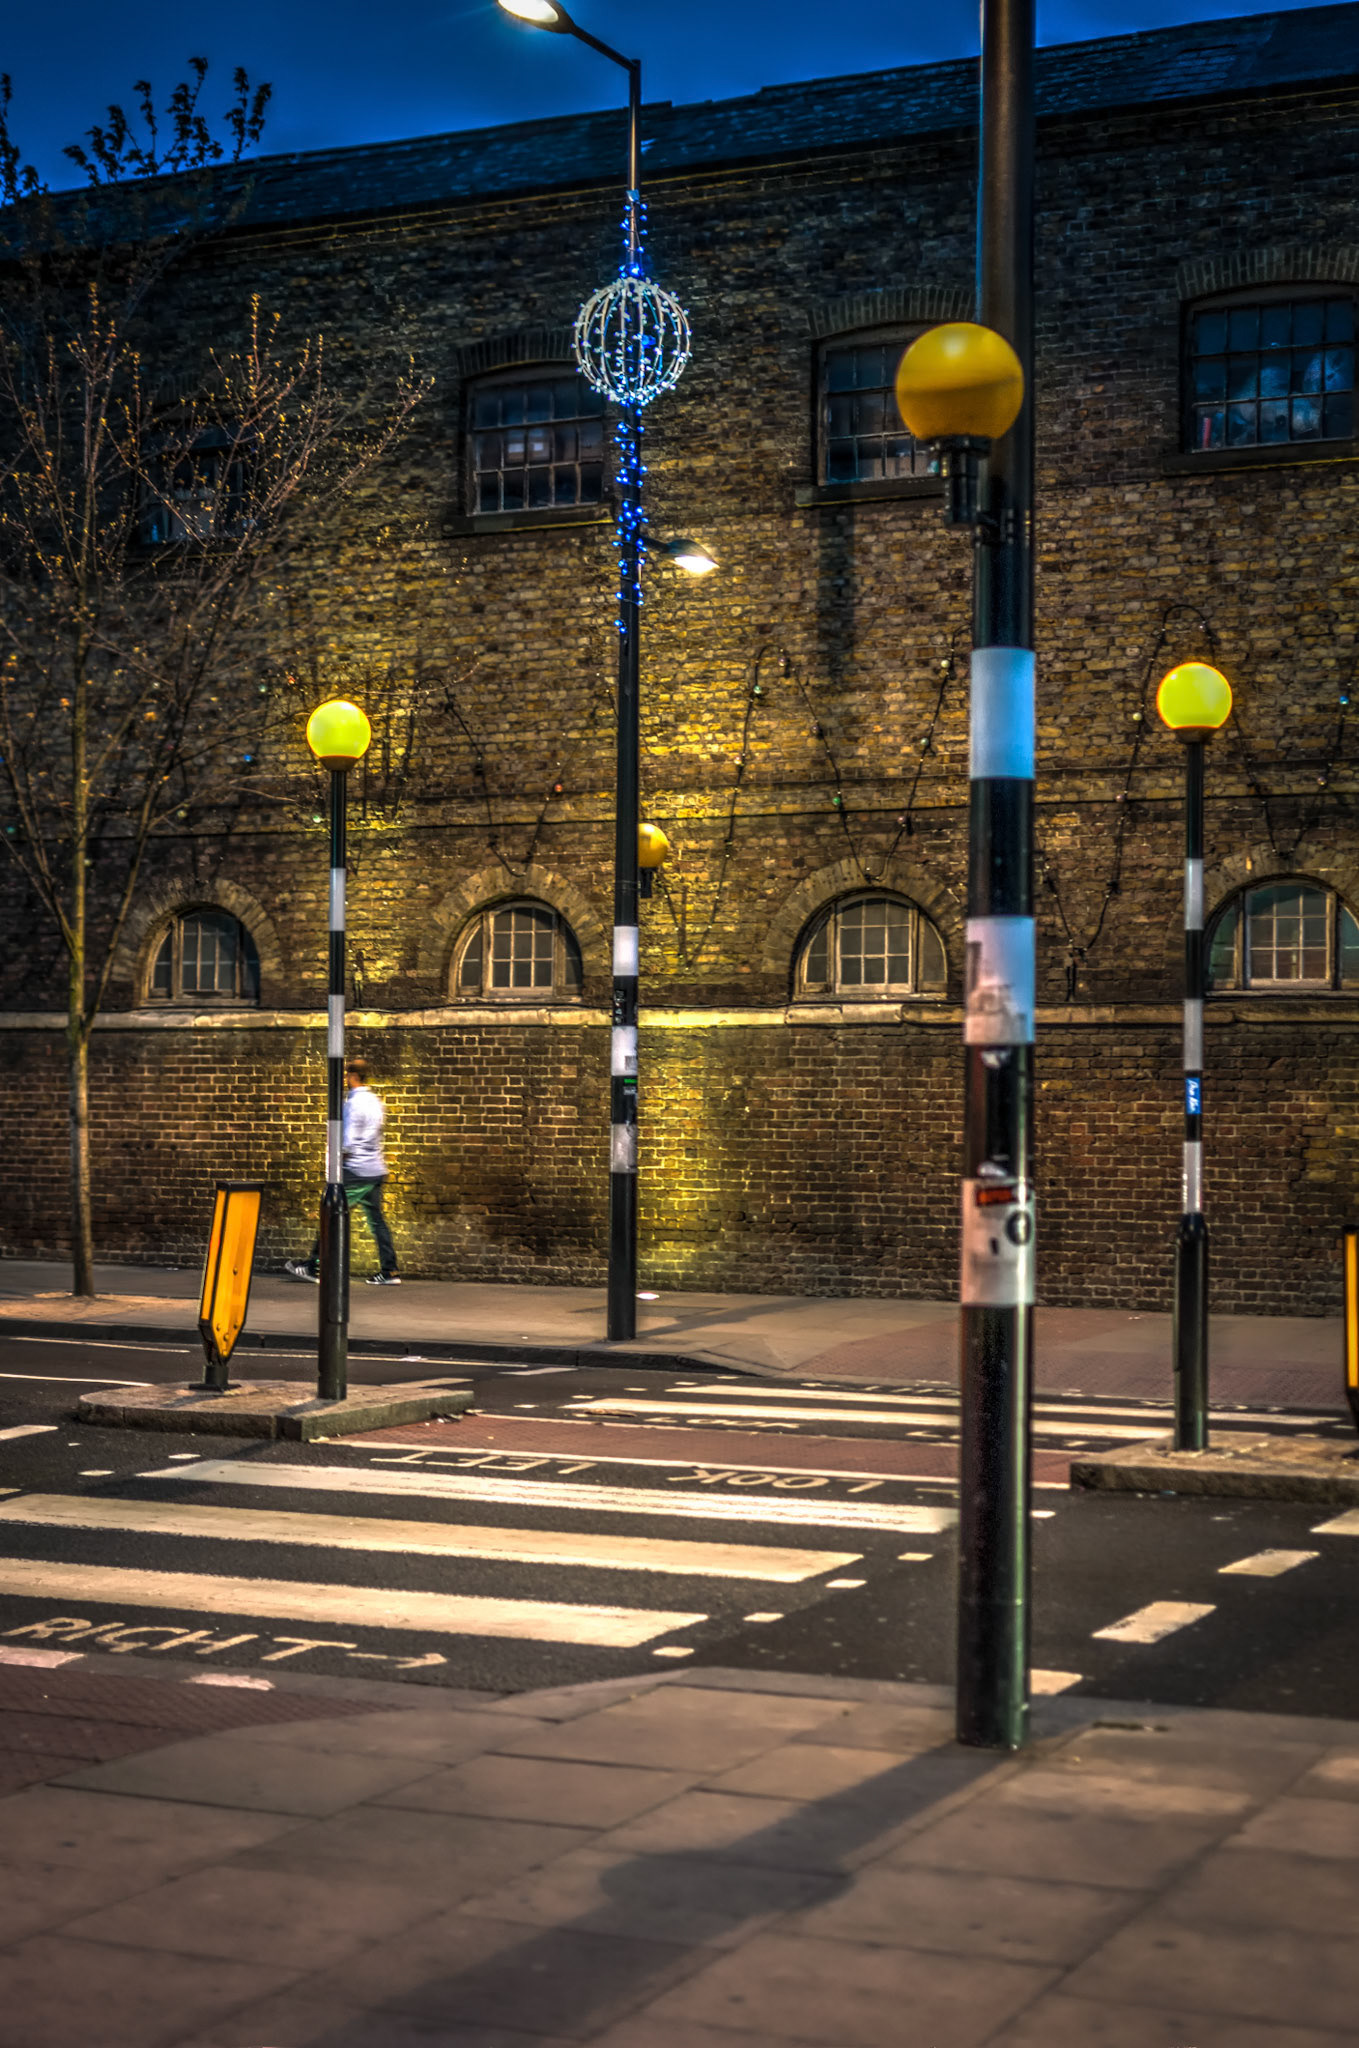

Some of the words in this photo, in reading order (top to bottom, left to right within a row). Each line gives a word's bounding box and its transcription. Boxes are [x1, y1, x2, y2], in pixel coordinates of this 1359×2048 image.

[643, 1416, 801, 1429] LOOK
[370, 1451, 597, 1474] LEFT
[667, 1469, 886, 1493] LOOK
[1, 1616, 358, 1661] RIGHT
